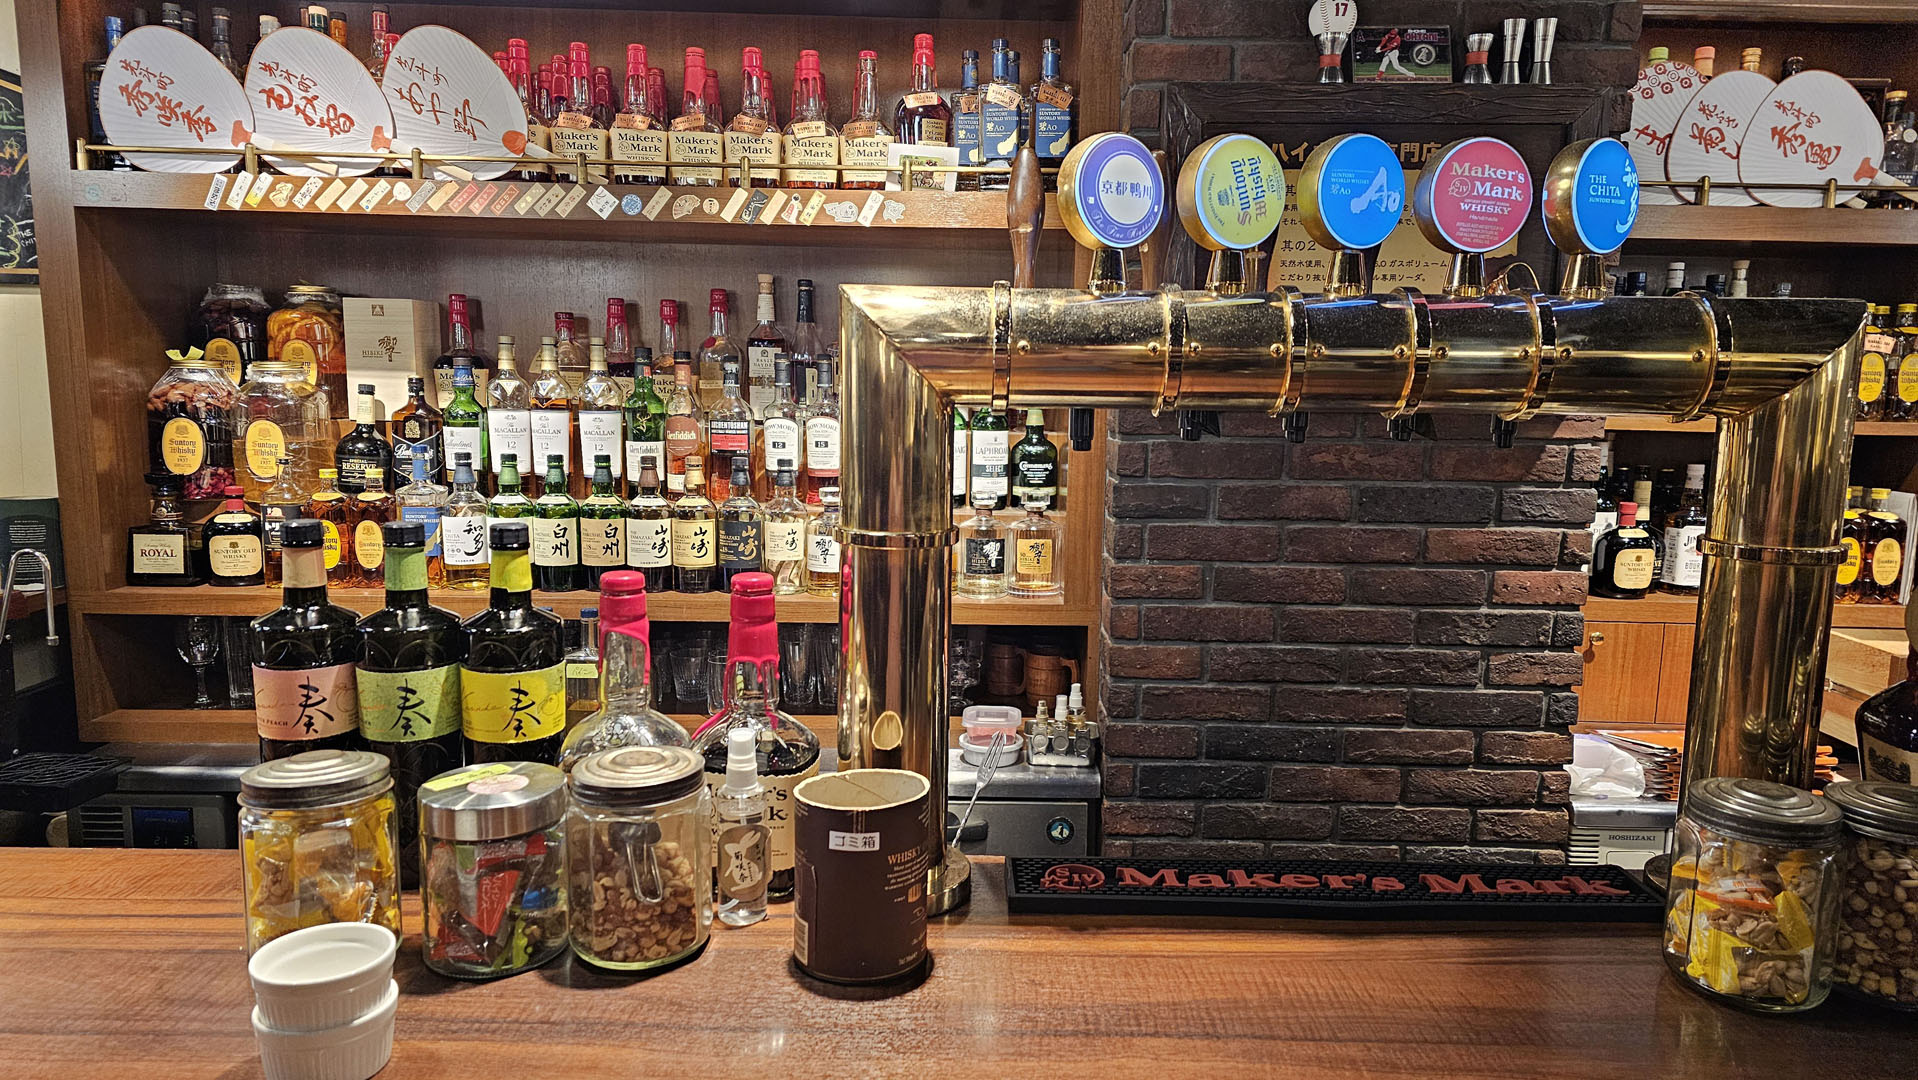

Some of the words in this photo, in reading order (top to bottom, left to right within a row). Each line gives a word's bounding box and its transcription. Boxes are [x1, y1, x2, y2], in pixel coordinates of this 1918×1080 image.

[1335, 3, 1348, 17] 17
[1405, 33, 1439, 42] OHTANI
[554, 131, 599, 141] Maker's
[617, 132, 662, 144] Maker's
[675, 136, 718, 146] Maker's
[566, 141, 598, 151] Mark
[729, 136, 773, 147] Maker's
[791, 139, 833, 149] Maker's
[845, 139, 888, 149] Maker's
[630, 143, 661, 153] Mark
[687, 145, 718, 155] Mark
[741, 146, 773, 155] Mark
[802, 148, 833, 158] Mark
[856, 148, 888, 158] Mark
[1450, 161, 1526, 185] Maker's
[1589, 174, 1608, 184] THE
[1101, 180, 1152, 201] 京都鴨川
[1230, 158, 1252, 226] Suntory
[1247, 156, 1267, 223] Whisky
[1471, 181, 1524, 203] Mark
[1590, 184, 1621, 198] CHITA
[1460, 202, 1512, 215] WHISKY
[1281, 240, 1316, 252] 其の2
[168, 438, 197, 448] Suntory
[251, 441, 279, 450] Suntory
[507, 441, 517, 449] 12
[540, 442, 550, 450] 12
[169, 447, 196, 457] Whisky
[253, 449, 278, 457] Whisky
[342, 462, 377, 470] RESERVE
[986, 465, 1004, 473] SELECT
[552, 523, 569, 559] 白州
[602, 523, 619, 558] 白州
[651, 524, 670, 558] 山崎
[690, 526, 710, 558] 山崎
[738, 525, 759, 561] 山崎
[785, 528, 799, 552] 山崎
[140, 549, 177, 558] ROYAL
[292, 675, 335, 735] 奏
[389, 678, 432, 737] 奏
[501, 679, 542, 738] 奏
[834, 835, 877, 850] ゴミ箱
[1608, 834, 1656, 842] HOSHIZAKI
[1115, 866, 1406, 892] Maker's
[1418, 873, 1631, 896] Mark
